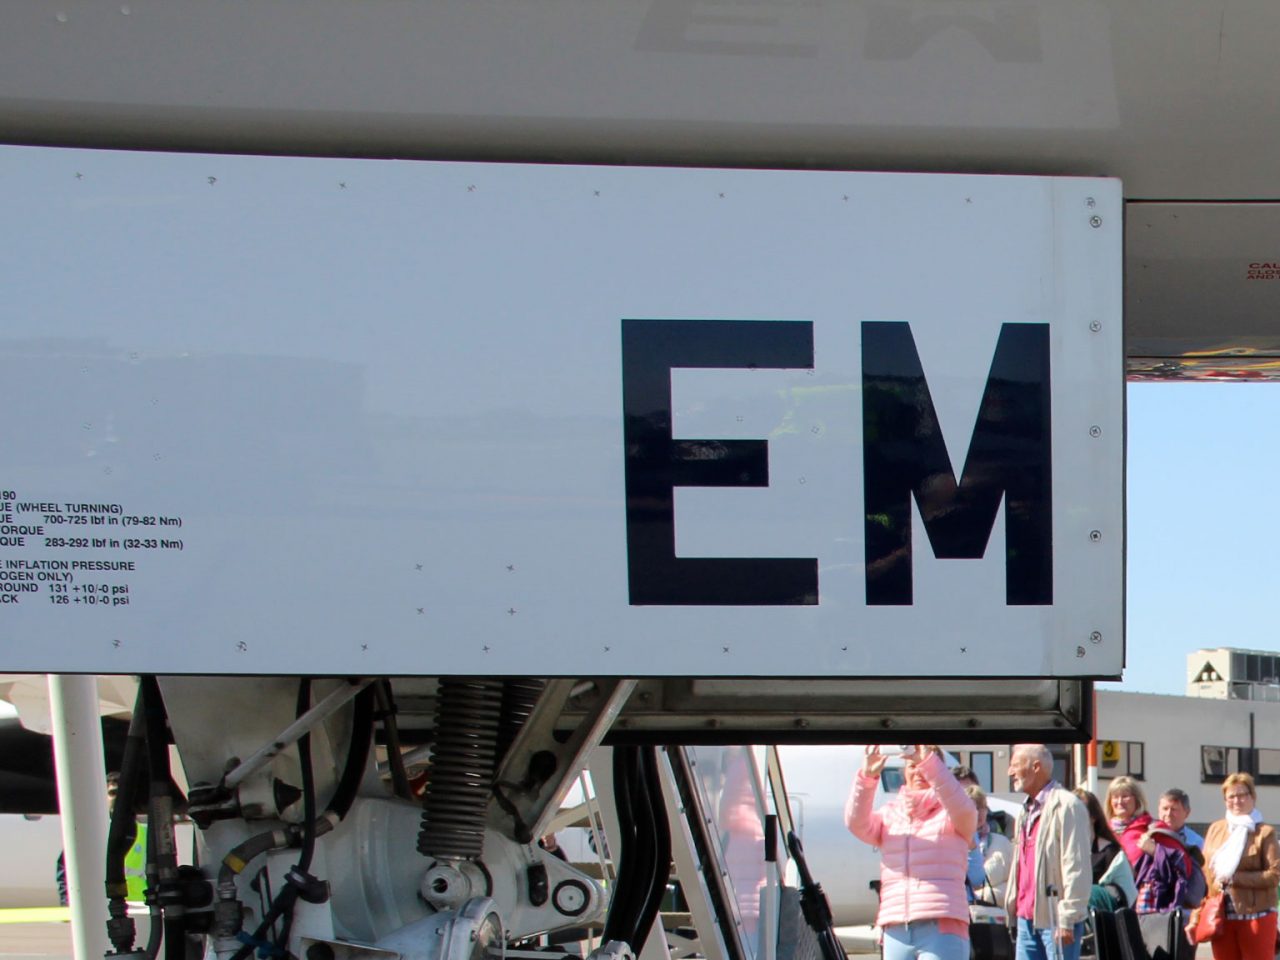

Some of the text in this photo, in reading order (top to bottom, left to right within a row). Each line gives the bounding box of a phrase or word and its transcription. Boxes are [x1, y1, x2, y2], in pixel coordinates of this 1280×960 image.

[621, 319, 1053, 605] EM
[16, 503, 61, 514] (WHEEL
[65, 504, 123, 515] TURNING)
[43, 515, 87, 525] 700-725
[108, 516, 118, 525] in
[122, 517, 156, 527] (79-82
[159, 517, 182, 528] Nm)
[45, 538, 88, 548] 283-292
[110, 539, 120, 548] in
[123, 540, 157, 550] (32-33
[161, 540, 183, 551] Nm)
[6, 560, 68, 570] INFLATION
[72, 561, 135, 571] PRESSURE
[37, 572, 73, 583] ONLY)
[49, 584, 67, 594] 131
[73, 584, 108, 595] +10/-0
[112, 584, 129, 597] psi
[50, 595, 69, 605] 126
[74, 595, 109, 605] +10/-0
[113, 595, 129, 607] psi
